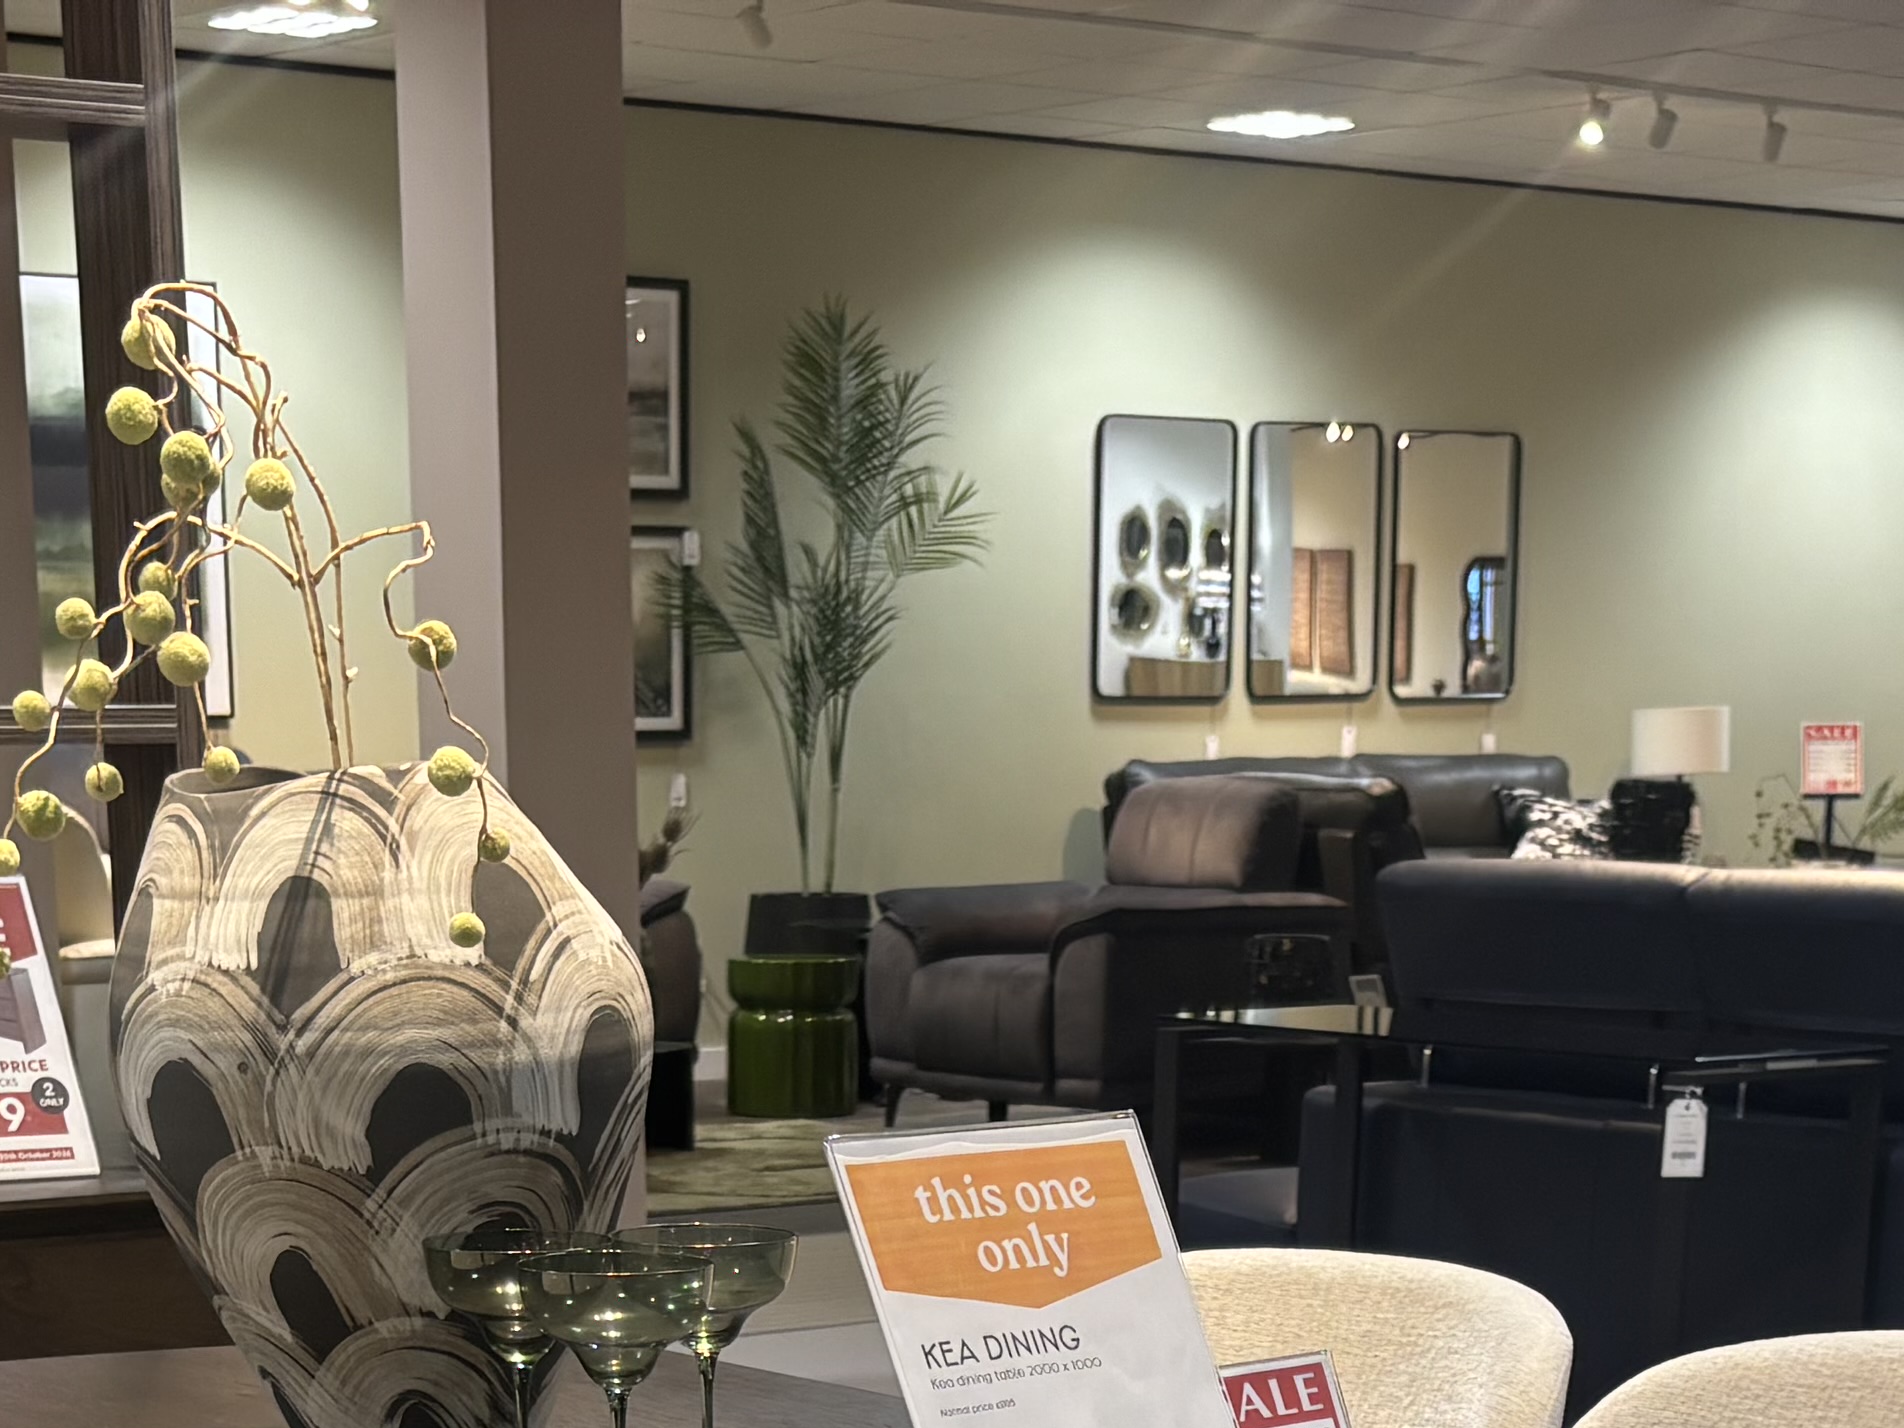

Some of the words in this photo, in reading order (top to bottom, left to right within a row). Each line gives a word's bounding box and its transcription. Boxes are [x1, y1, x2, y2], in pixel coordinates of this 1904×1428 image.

[0, 1059, 49, 1074] PRICE
[42, 1081, 56, 1097] 2
[914, 1174, 1007, 1223] this
[1015, 1176, 1096, 1213] one
[977, 1221, 1069, 1278] only
[921, 1338, 980, 1369] KEA
[983, 1325, 1080, 1360] DINING
[930, 1377, 955, 1390] Kea
[957, 1373, 992, 1387] dining
[995, 1367, 1025, 1382] table
[1027, 1362, 1060, 1377] 2000
[1063, 1363, 1070, 1372] x
[1071, 1356, 1102, 1371] 1000
[1239, 1372, 1324, 1422] ALE
